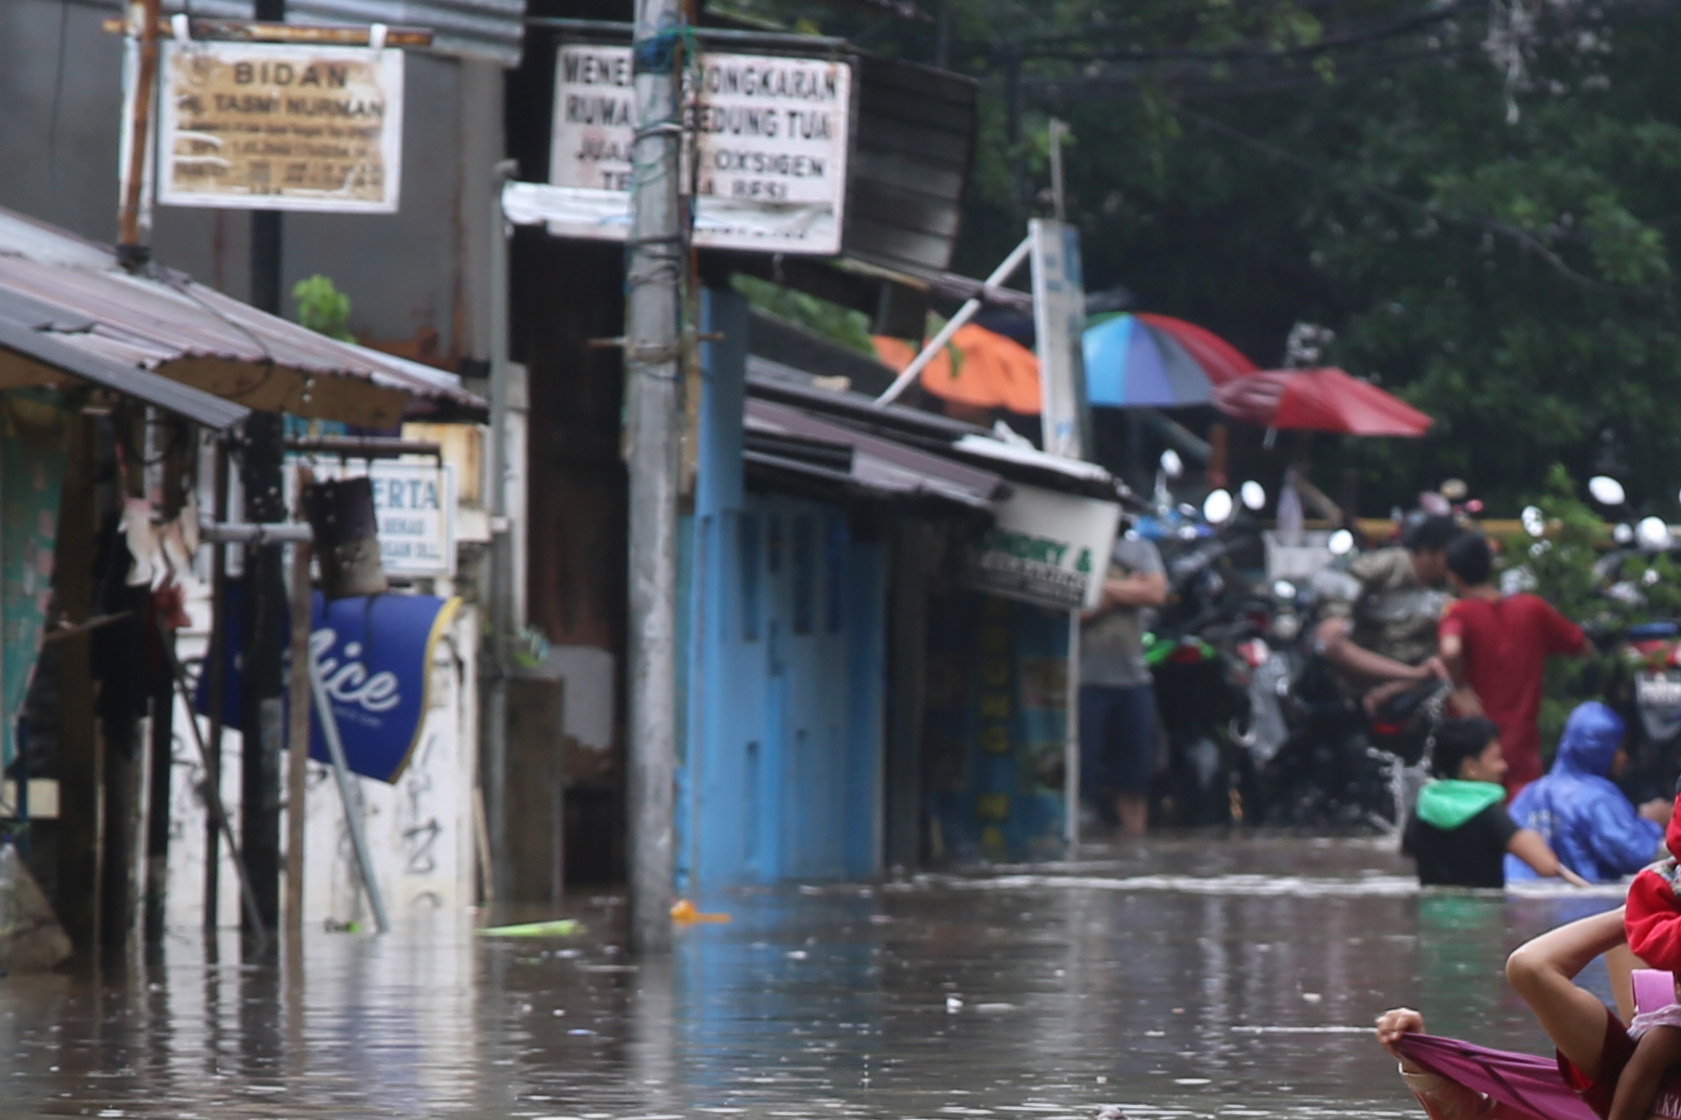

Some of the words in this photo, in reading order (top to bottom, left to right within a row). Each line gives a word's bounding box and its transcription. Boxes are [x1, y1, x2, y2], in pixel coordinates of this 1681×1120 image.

[234, 61, 348, 88] BIDAN
[700, 64, 837, 101] ONGKARAN
[565, 93, 632, 126] RUMA
[788, 107, 832, 140] TUA
[372, 478, 440, 510] ERTA
